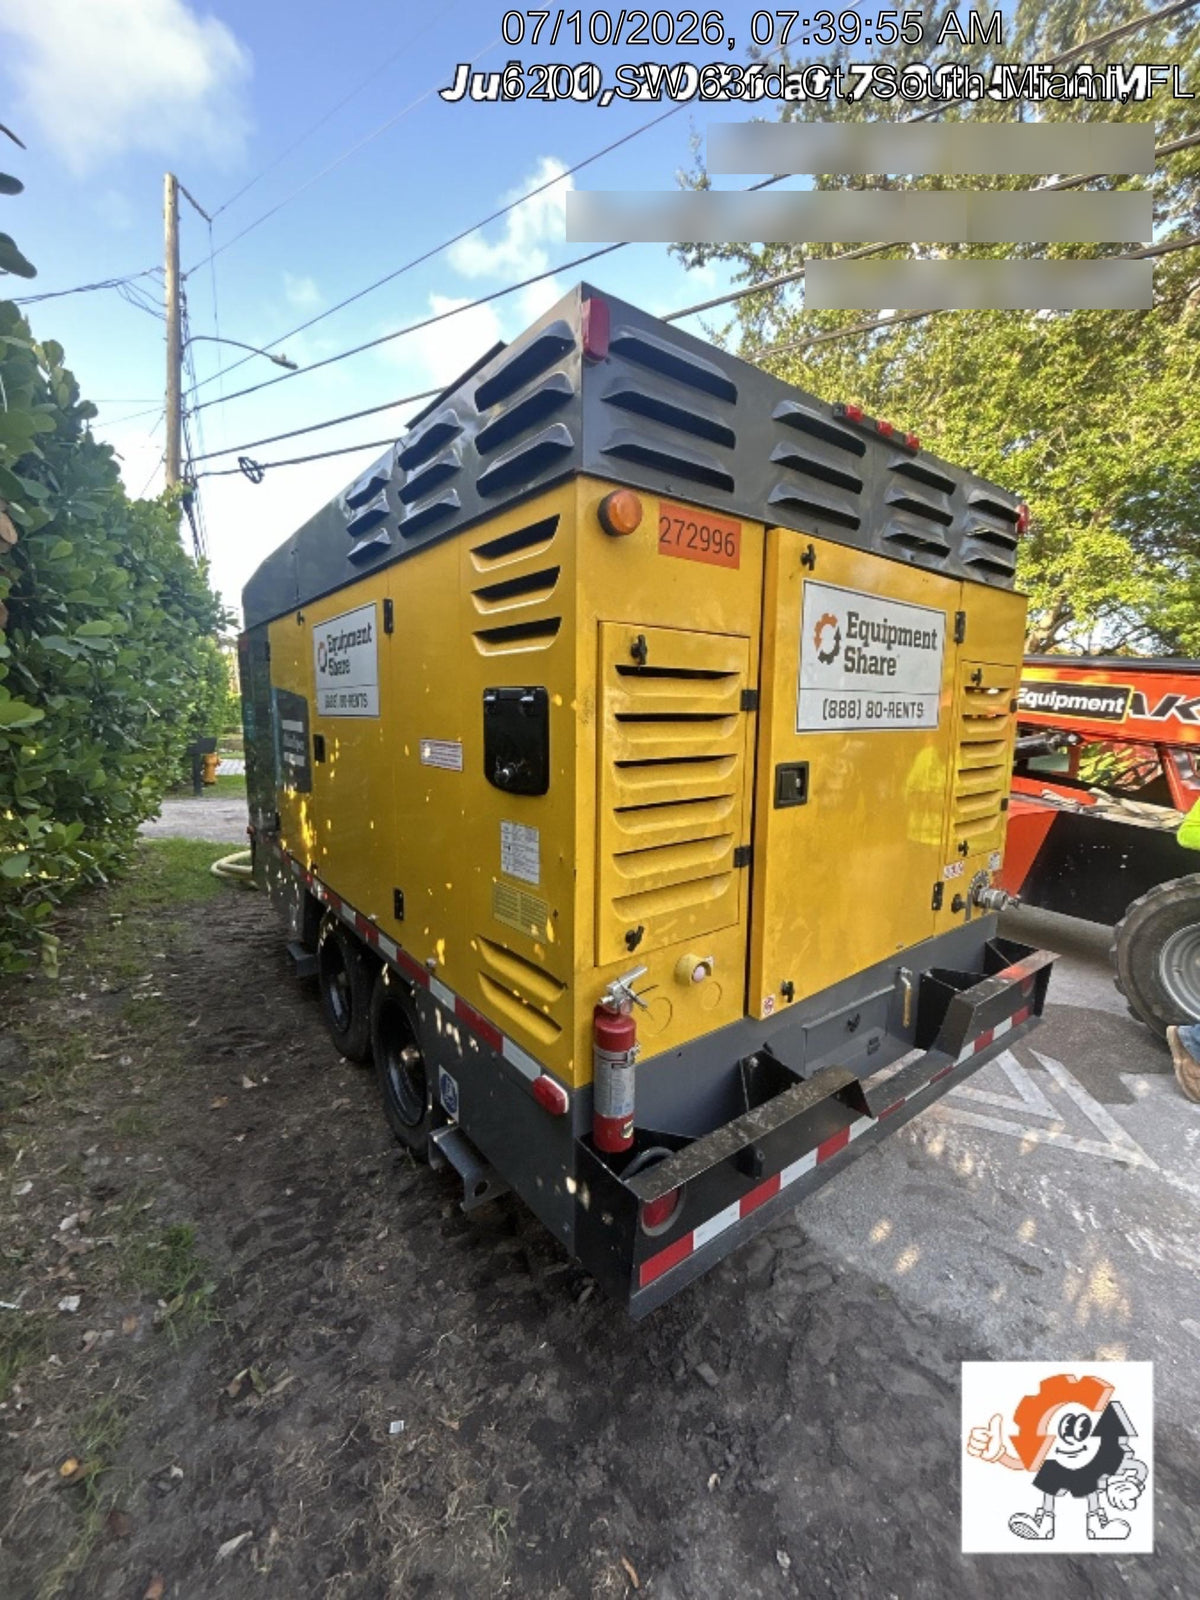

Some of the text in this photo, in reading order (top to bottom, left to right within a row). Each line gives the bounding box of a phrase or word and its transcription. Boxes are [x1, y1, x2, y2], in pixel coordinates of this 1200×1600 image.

[659, 516, 735, 557] 272996
[327, 622, 373, 657] Equipment
[846, 611, 938, 650] Equipment
[844, 646, 897, 676] Share
[822, 698, 924, 720] (888) 80-RENTS
